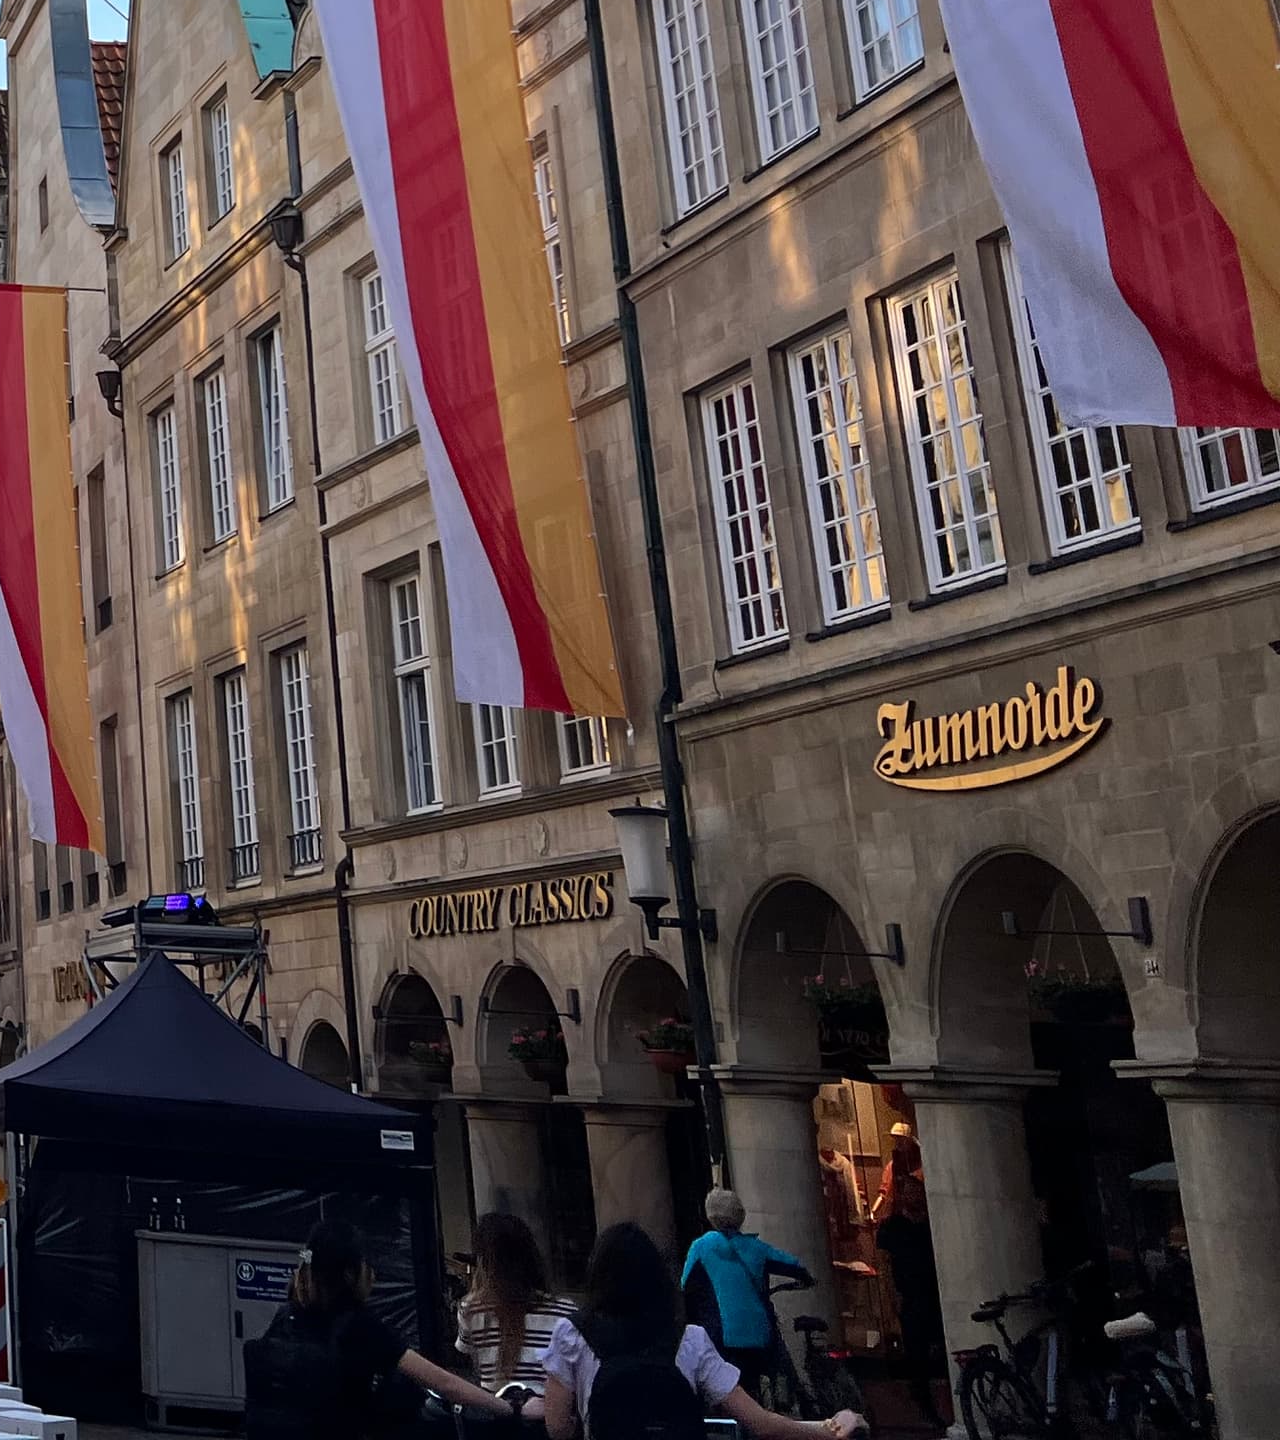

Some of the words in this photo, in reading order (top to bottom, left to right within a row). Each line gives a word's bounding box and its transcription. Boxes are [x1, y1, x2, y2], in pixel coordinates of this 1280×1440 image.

[873, 664, 1100, 780] Zumnorde
[408, 888, 503, 938] COUNTRY
[509, 872, 613, 927] CLASSICS
